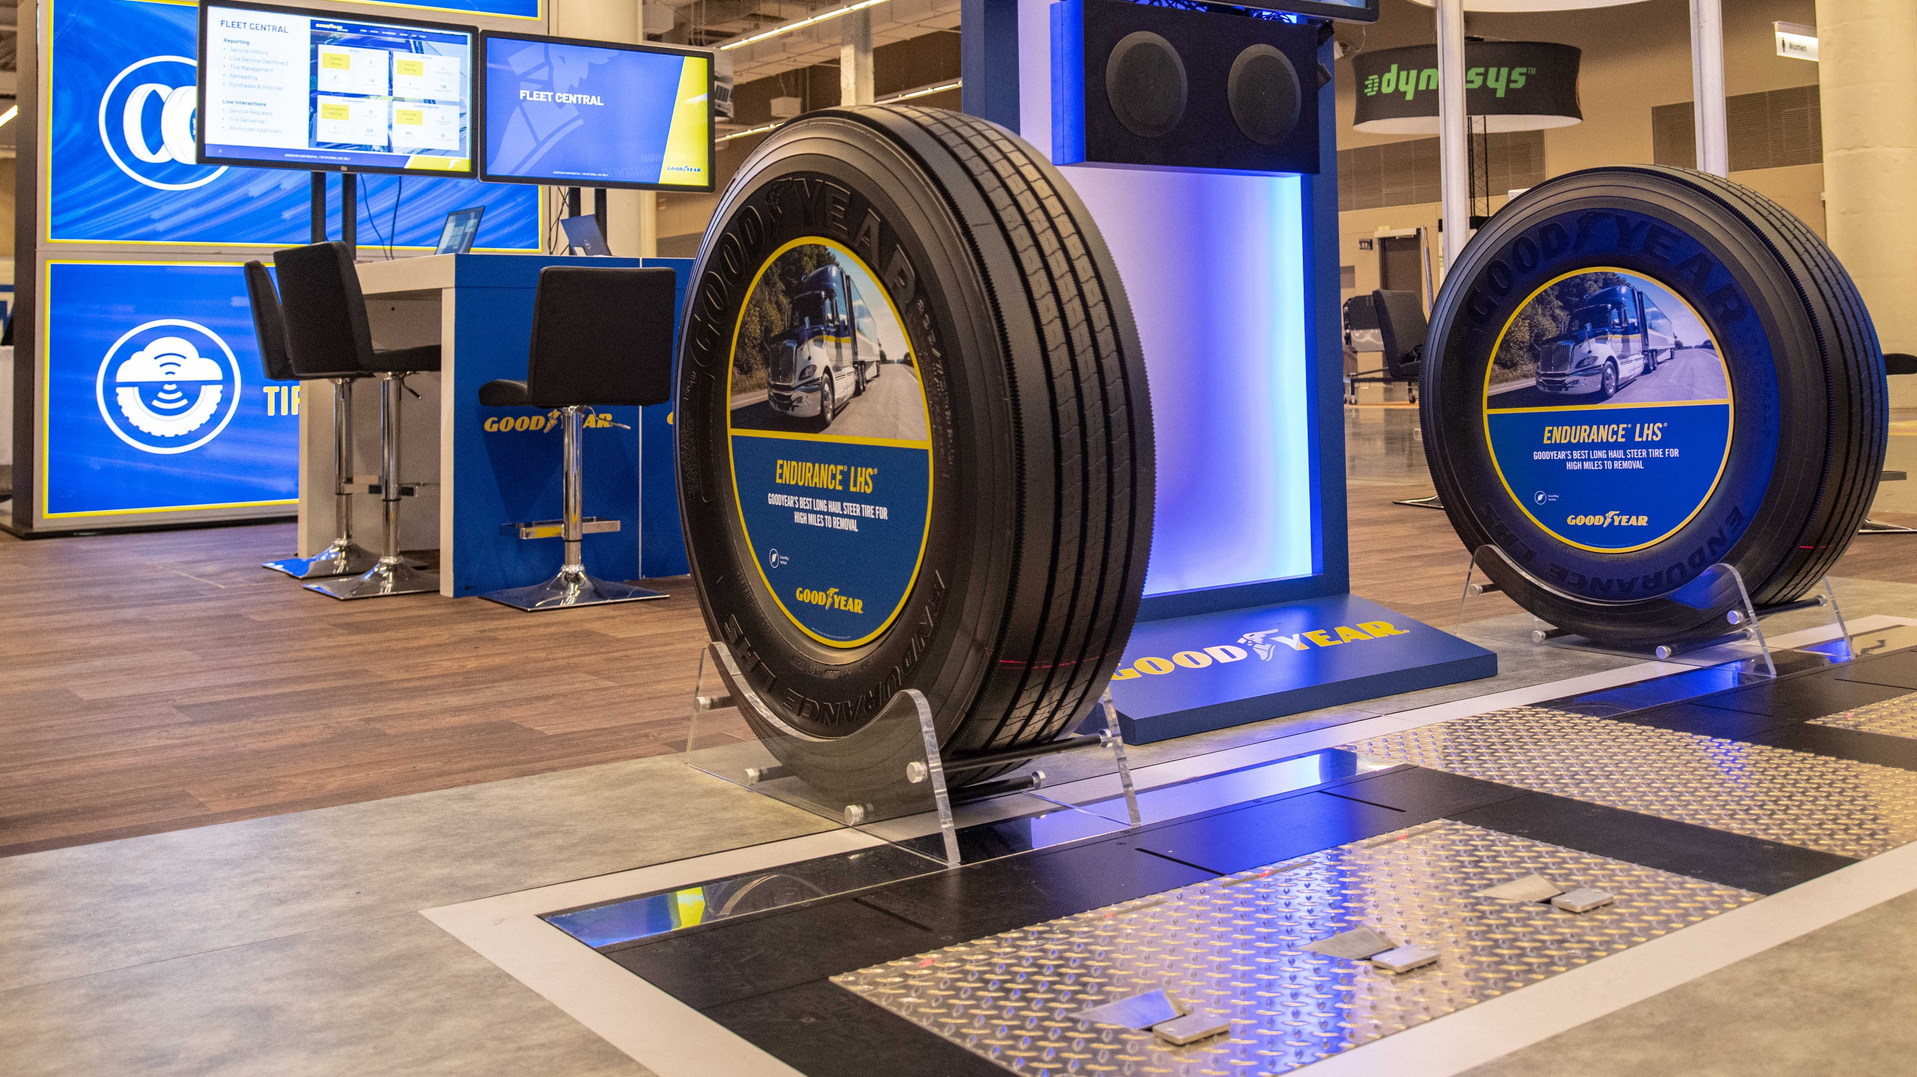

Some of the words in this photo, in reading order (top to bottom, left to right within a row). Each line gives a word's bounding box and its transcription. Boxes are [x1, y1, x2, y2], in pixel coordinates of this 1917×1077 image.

[220, 20, 247, 29] FLEET
[250, 23, 289, 33] CENTRAL
[224, 38, 250, 46] Reporting
[1789, 42, 1807, 52] Women
[520, 90, 553, 102] FLEET
[556, 92, 604, 106] CENTRAL
[691, 176, 916, 368] GOODYEAR
[1466, 212, 1748, 328] GOODYEAR
[484, 410, 613, 433] GOODAR
[1533, 450, 1571, 460] GOODYEAR'S
[1573, 450, 1589, 459] BEST
[1590, 450, 1606, 459] LONG
[1608, 450, 1624, 458] HAUL
[1626, 449, 1647, 458] STEER
[1649, 449, 1664, 458] TIRE
[1666, 448, 1679, 457] FOR
[1566, 461, 1582, 470] HIGH
[1584, 461, 1602, 470] MILES
[1604, 461, 1612, 469] TO
[1614, 460, 1644, 469] REMOVAL
[768, 493, 798, 508] GOODYEAR'S
[800, 497, 812, 510] BEST
[813, 499, 827, 512] LONG
[828, 501, 842, 514] HAUL
[843, 502, 860, 517] STEER
[862, 505, 874, 518] TIRE
[876, 507, 888, 520] FOR
[794, 511, 807, 524] HIGH
[808, 513, 824, 527] MILES
[825, 516, 832, 528] TO
[833, 517, 858, 532] REMOVAL
[1567, 511, 1648, 528] GOODYEAR
[796, 588, 863, 614] GOODYEAR
